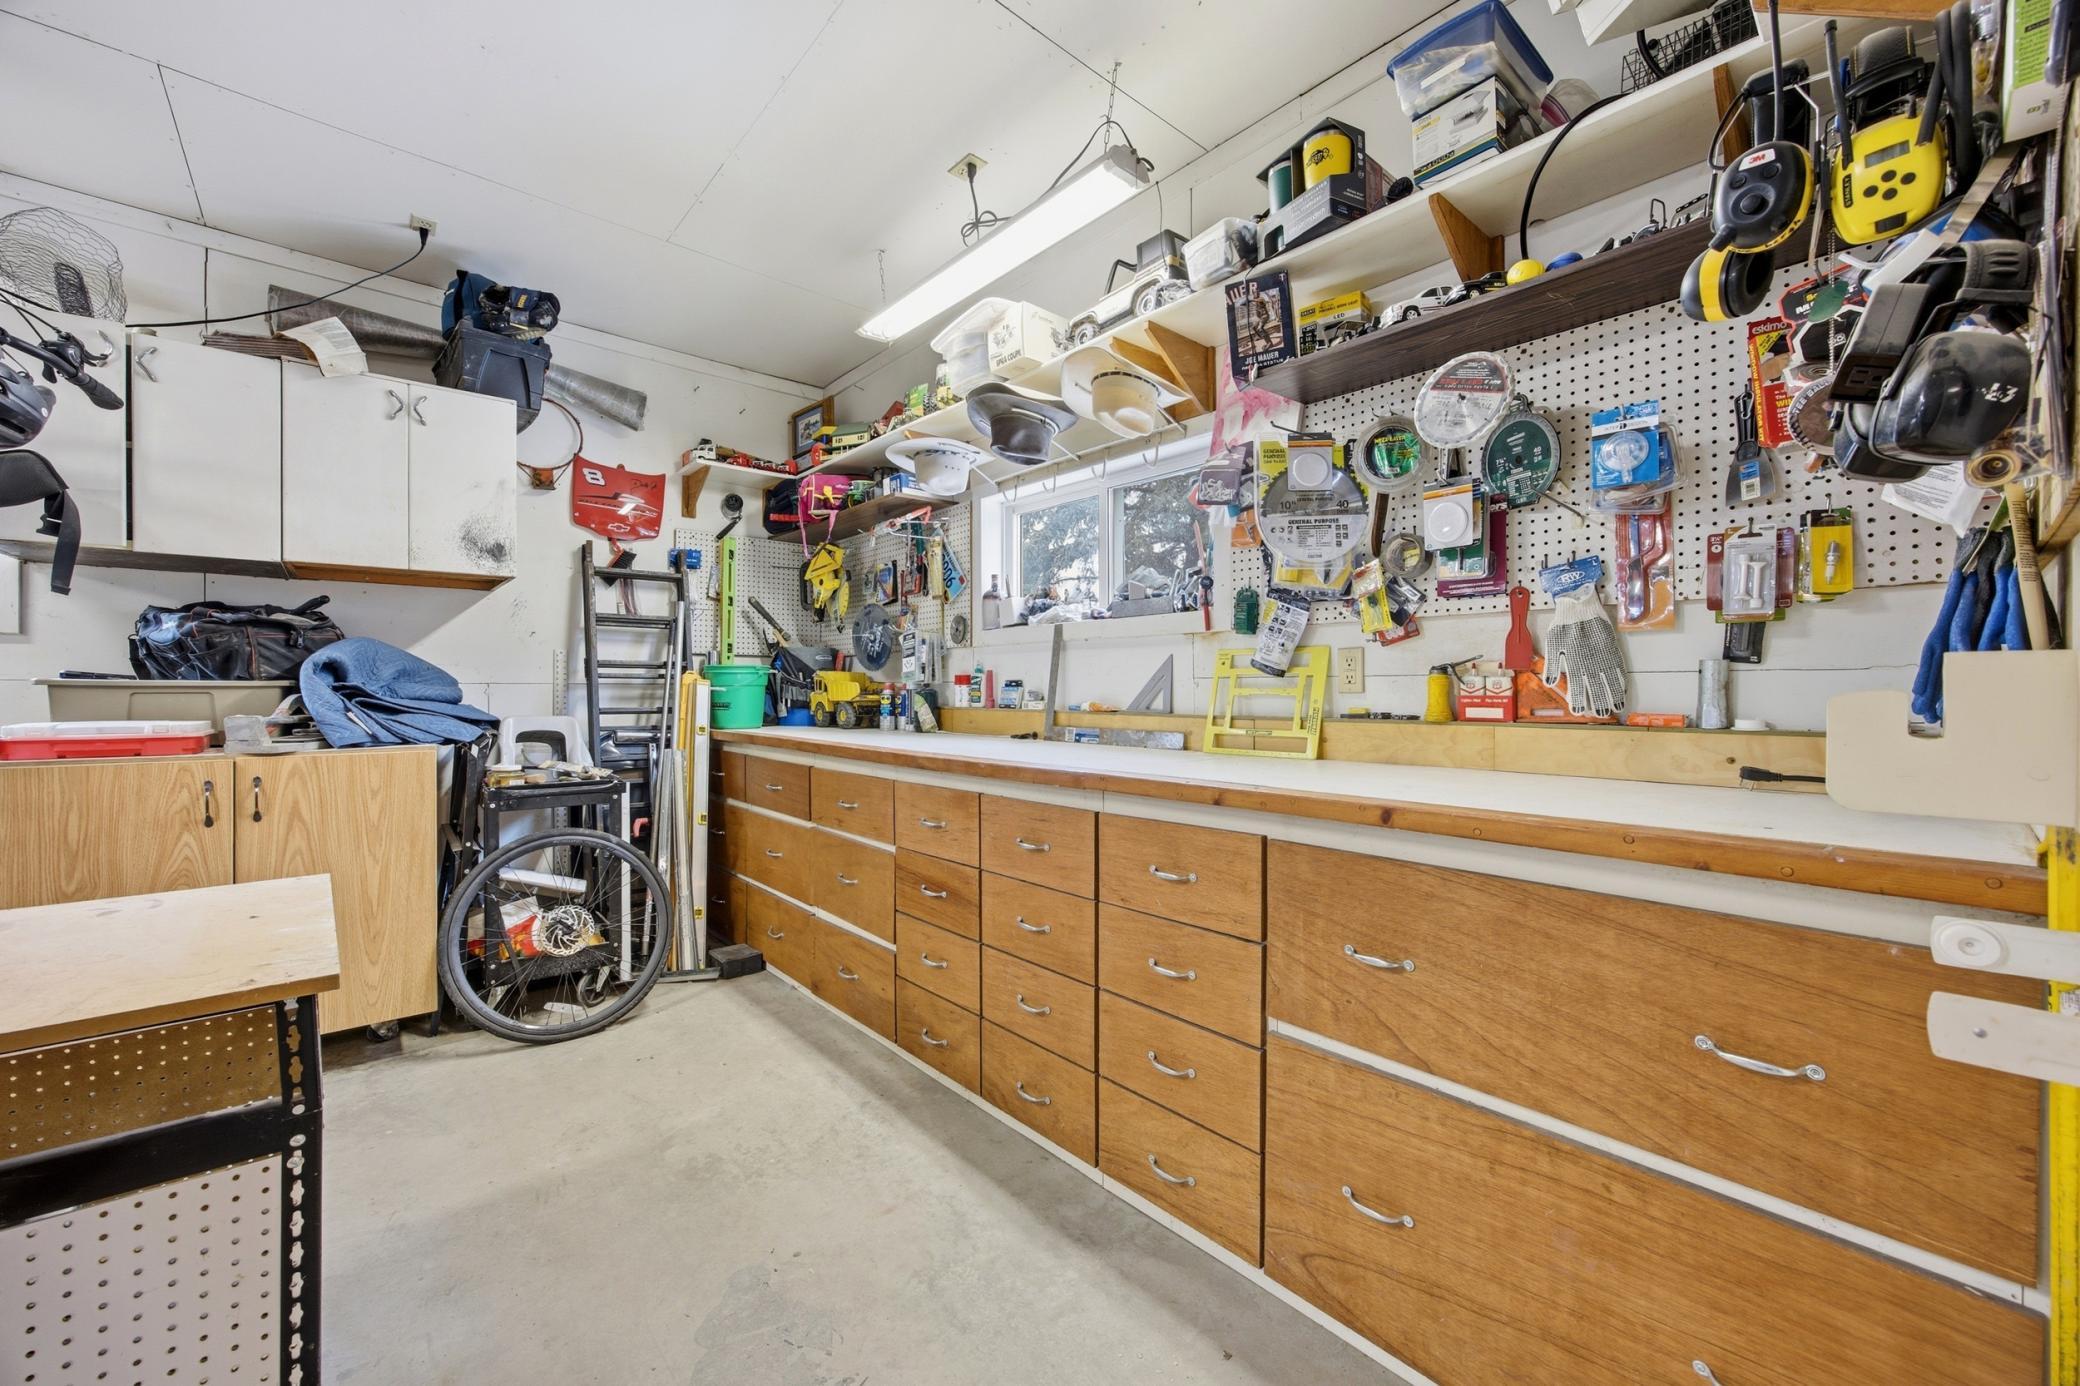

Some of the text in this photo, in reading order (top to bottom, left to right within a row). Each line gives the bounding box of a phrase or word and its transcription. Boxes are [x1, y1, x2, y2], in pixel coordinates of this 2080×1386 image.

[1748, 153, 1766, 164] 3M
[1844, 177, 1852, 207] STANLEY
[1752, 321, 1788, 335] eskimo
[1257, 351, 1280, 362] MAUER
[582, 467, 606, 488] 8
[1336, 499, 1349, 509] 40
